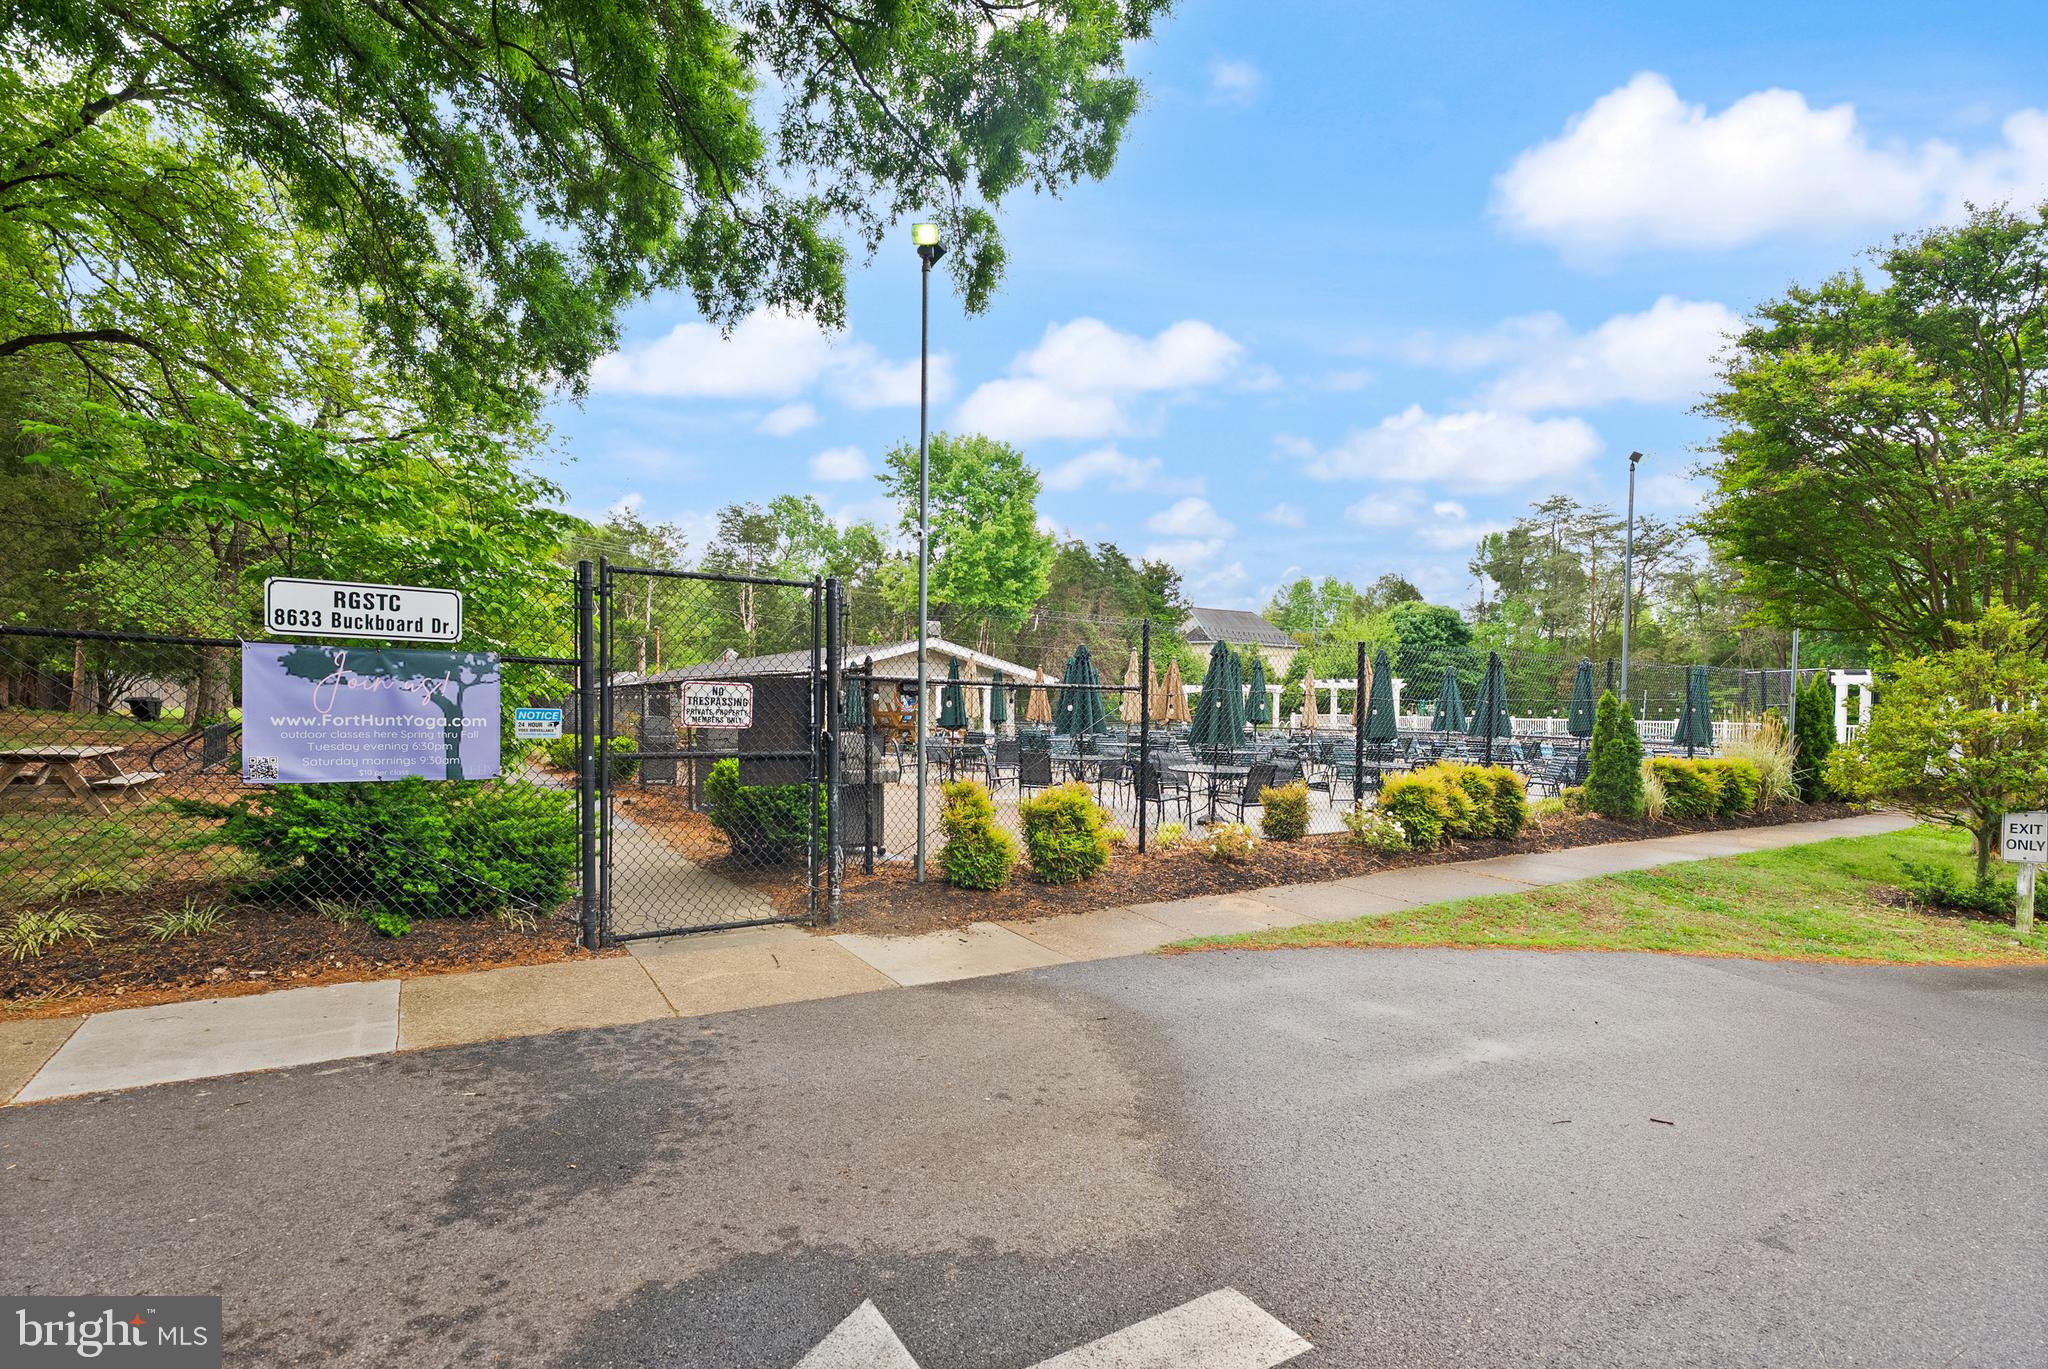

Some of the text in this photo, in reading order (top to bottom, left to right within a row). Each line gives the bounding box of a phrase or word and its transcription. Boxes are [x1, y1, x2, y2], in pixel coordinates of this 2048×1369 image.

[333, 590, 401, 612] RGSTC
[274, 608, 454, 635] 8633 Buckboard Dr.
[313, 650, 451, 713] Join us!
[712, 686, 724, 696] NO
[687, 696, 749, 707] TRESPASSING
[518, 711, 560, 720] NOTICE
[686, 708, 748, 716] PRIVATE PROPERTY
[270, 714, 487, 729] www.FortHuntYoga.com
[691, 716, 742, 724] MEMBERS ONLY
[280, 730, 479, 740] outdoor classes here Spring thru Fall
[307, 742, 453, 752] Tuesday evening 6:30pm
[302, 756, 460, 767] Saturday mornings 9:30am
[2010, 823, 2044, 835] EXIT
[2006, 839, 2046, 852] ONLY
